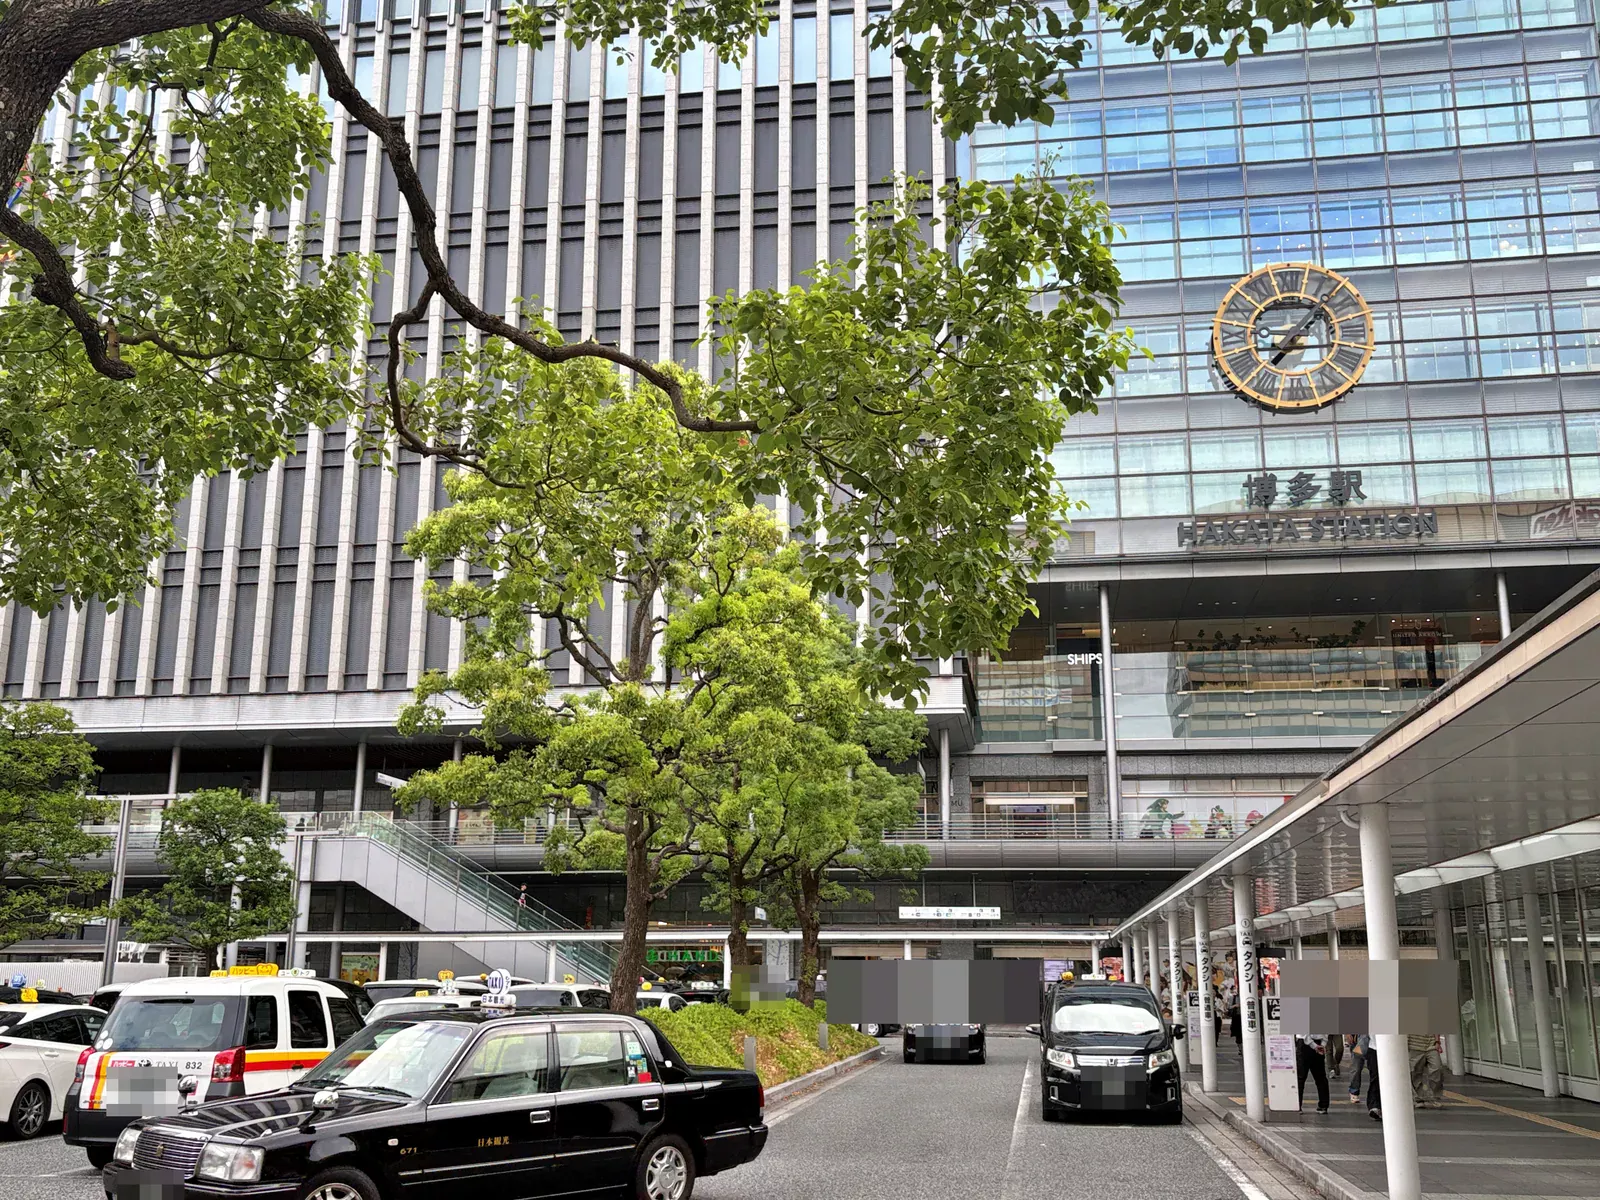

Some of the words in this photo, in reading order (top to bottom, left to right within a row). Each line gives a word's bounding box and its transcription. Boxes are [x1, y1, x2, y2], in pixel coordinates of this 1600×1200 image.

[1243, 470, 1367, 507] 博多駅
[1178, 518, 1300, 546] HAKATA
[1309, 511, 1438, 541] STATION
[1067, 653, 1102, 665] SHIPS
[667, 949, 725, 962] HAND
[232, 967, 255, 975] ハッピー
[482, 995, 505, 1004] 日本観光
[185, 1061, 202, 1069] 832
[477, 1136, 509, 1147] 日本観光
